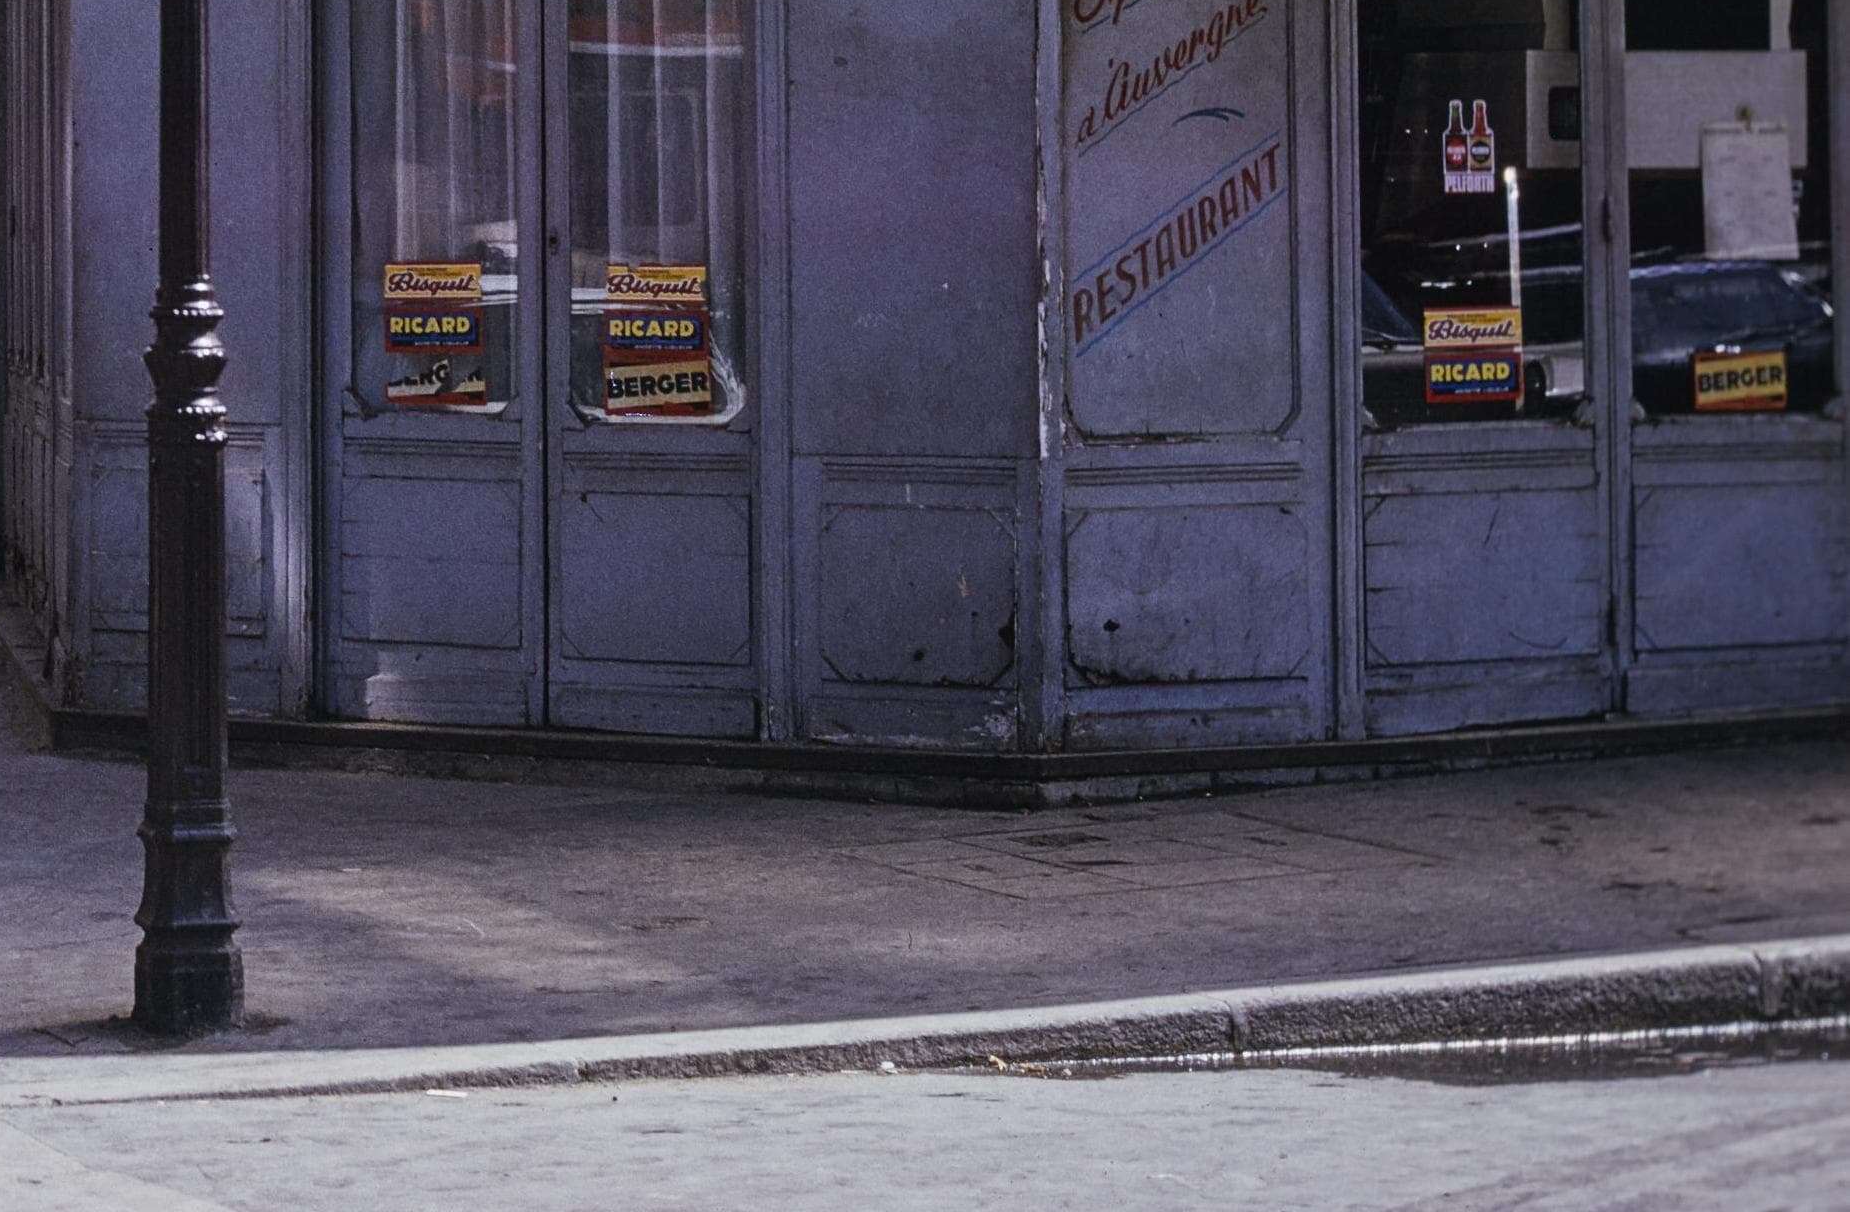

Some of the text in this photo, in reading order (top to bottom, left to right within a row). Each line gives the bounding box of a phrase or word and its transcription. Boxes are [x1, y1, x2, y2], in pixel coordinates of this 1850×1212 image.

[1445, 174, 1495, 192] PELFORTH
[1073, 143, 1281, 345] RESTAURANT
[389, 272, 477, 296] Bisquit
[607, 274, 702, 298] Bisquit
[390, 316, 470, 334] RICARD
[609, 319, 695, 337] RICARD
[1428, 319, 1517, 342] Bisquit
[1430, 362, 1510, 383] RICARD
[1697, 365, 1783, 393] BERGER
[607, 371, 708, 399] BERGER
